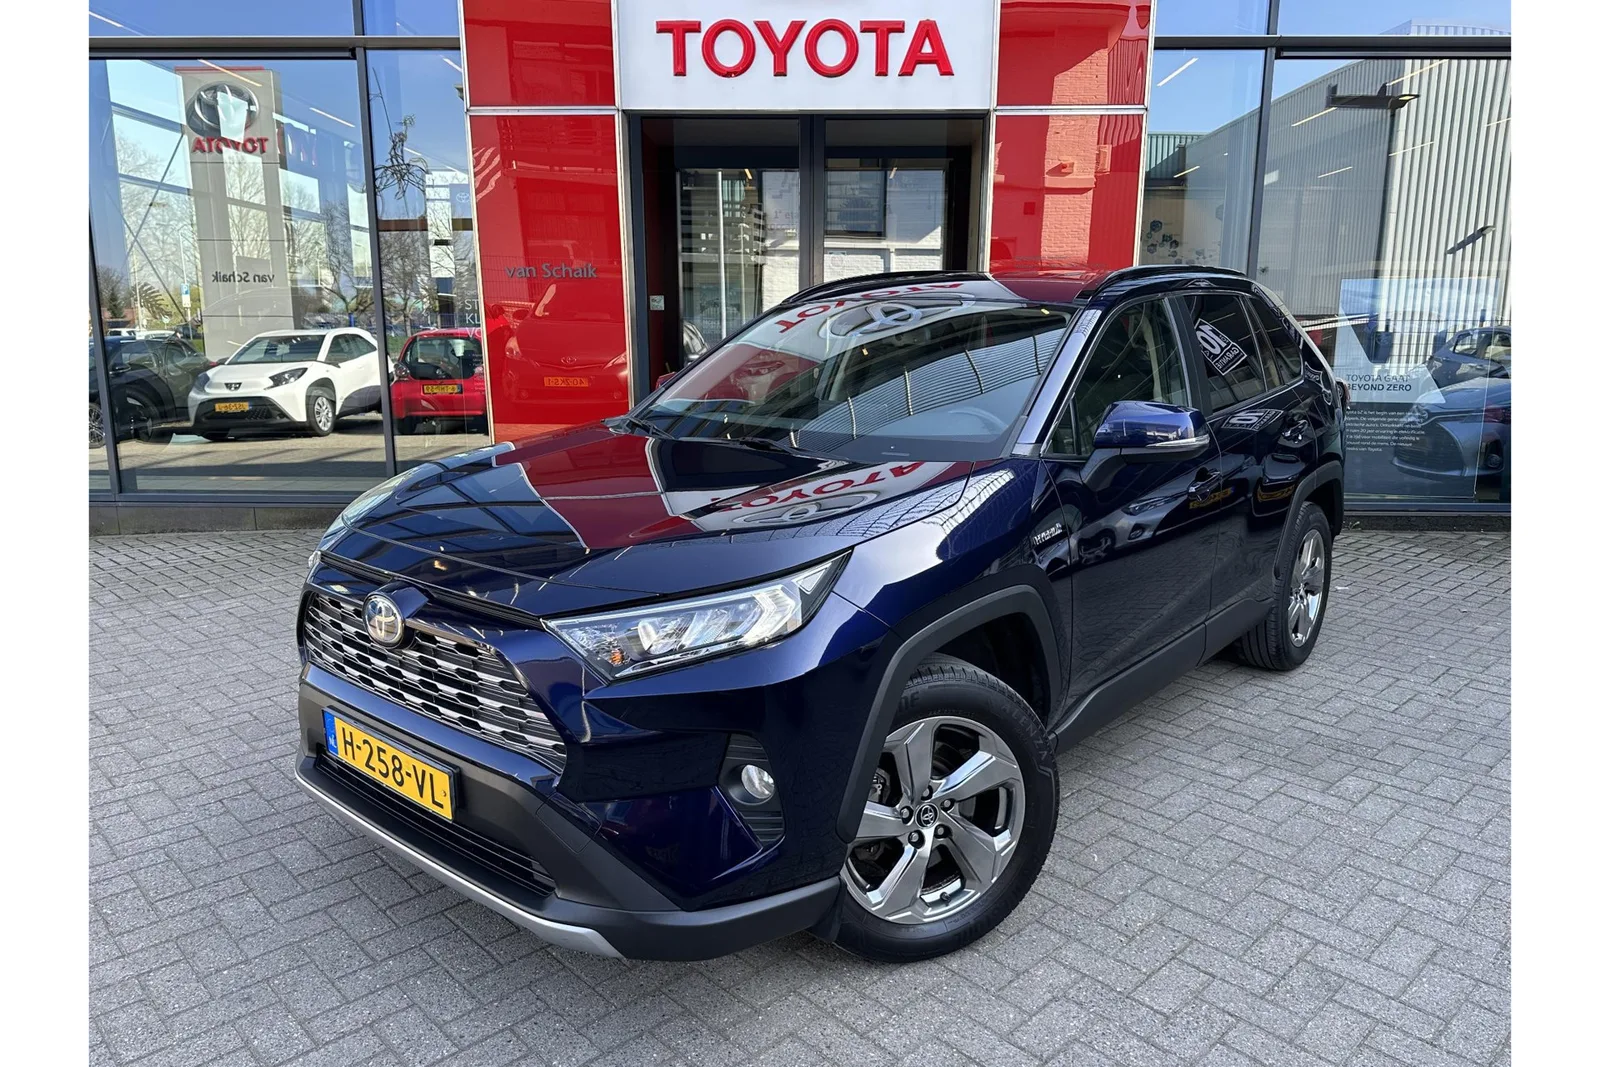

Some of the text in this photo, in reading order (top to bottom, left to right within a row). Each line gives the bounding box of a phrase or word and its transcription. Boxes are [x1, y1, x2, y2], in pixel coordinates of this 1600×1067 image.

[656, 18, 954, 78] TOYOTA
[505, 262, 597, 278] van Schaik
[1346, 374, 1382, 382] TOYOTA
[1347, 383, 1384, 391] BEYOND
[342, 726, 444, 809] H-258-VL
